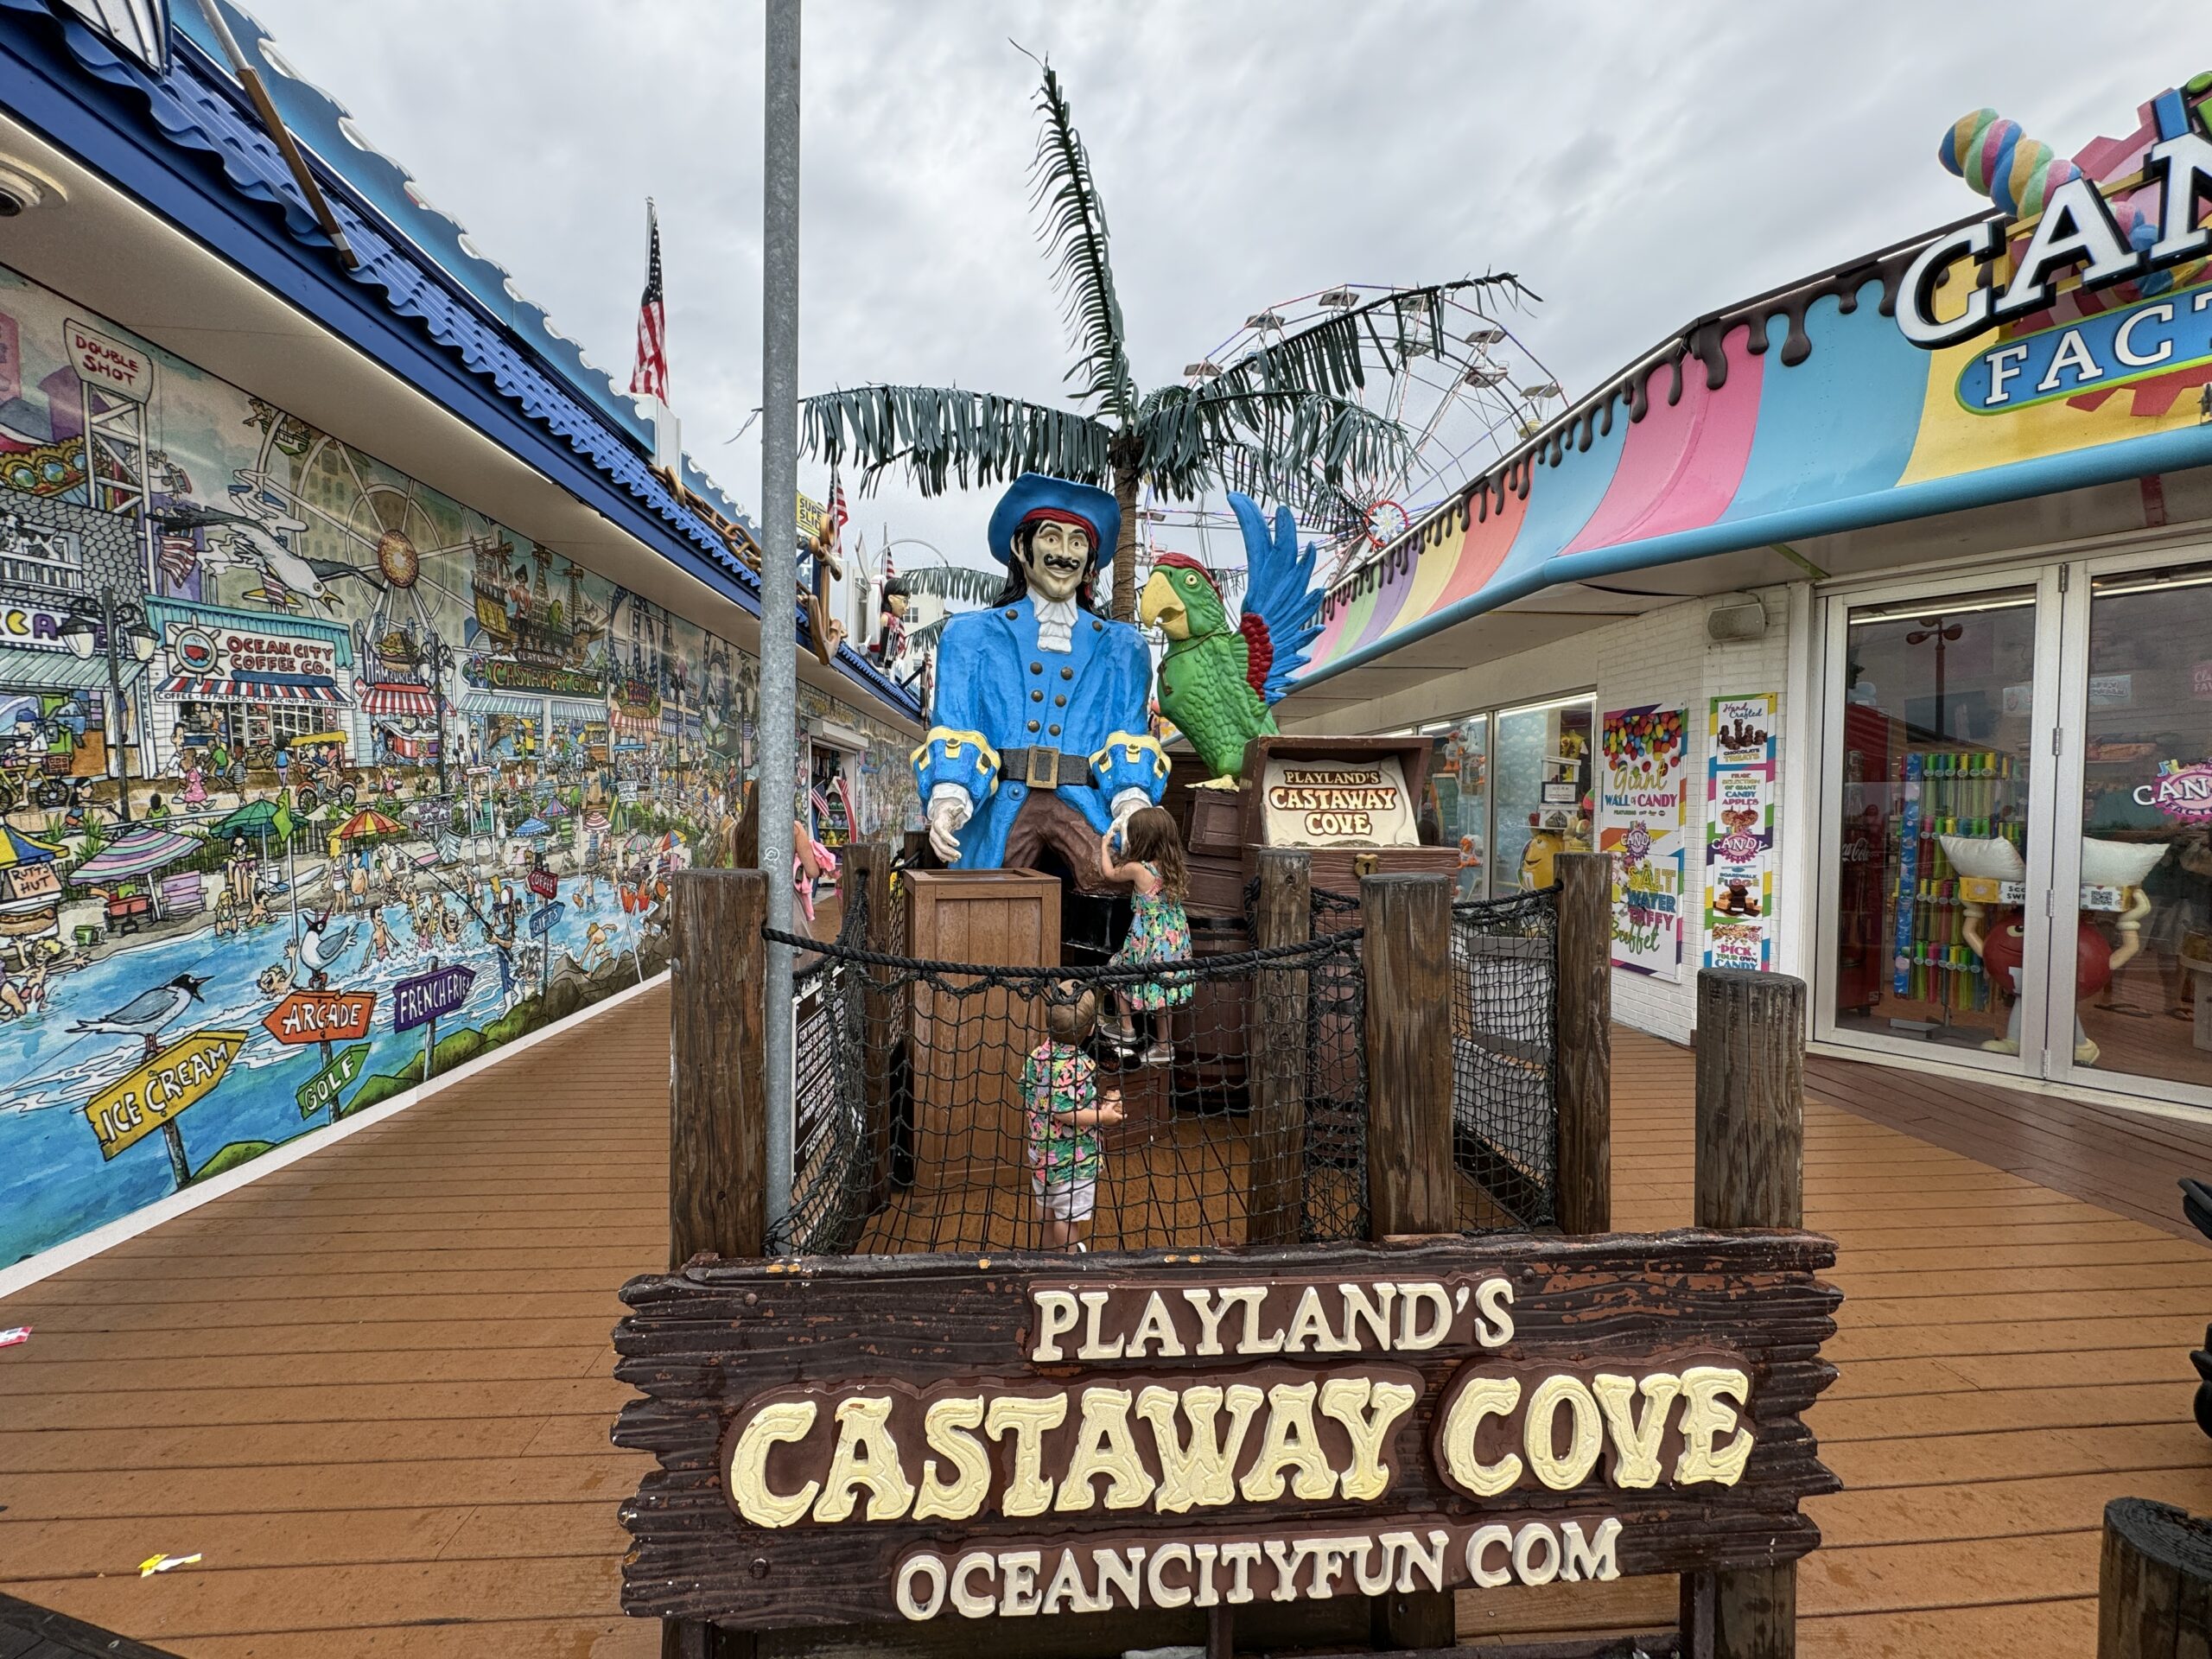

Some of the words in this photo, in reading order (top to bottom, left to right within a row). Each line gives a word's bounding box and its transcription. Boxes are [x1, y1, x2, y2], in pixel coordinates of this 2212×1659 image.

[75, 334, 139, 373] DOUBLE
[83, 353, 137, 386] SHOT
[800, 498, 822, 520] SUPE
[226, 635, 292, 656] OCEAN
[294, 647, 334, 664] CITY
[230, 655, 296, 673] COFFEE
[303, 658, 332, 676] CO.
[493, 662, 569, 691] CASTAWAY
[200, 694, 248, 702] ESPRESSO
[1723, 702, 1747, 714] Hand
[1730, 709, 1763, 719] Crafted
[1286, 770, 1380, 785] PLAYLAND'S
[1270, 787, 1395, 810] CASTAWAY
[1605, 794, 1630, 806] WALL
[1637, 793, 1677, 807] CANDY
[2133, 778, 2212, 805] CAN
[1306, 813, 1371, 835] COVE
[1712, 836, 1769, 853] CANDY
[21, 879, 50, 893] HUT
[531, 873, 556, 893] COFFEE
[1628, 866, 1676, 893] SALT
[1718, 877, 1759, 887] FUDGE
[1627, 890, 1676, 912] WATER
[532, 909, 560, 934] GIFTS
[1628, 908, 1675, 931] TAFFY
[1719, 944, 1751, 957] PICK
[1715, 959, 1758, 970] CANDY
[400, 977, 446, 1024] FRENCH
[283, 1002, 360, 1035] ARCADE
[100, 1093, 143, 1141] ICE
[144, 1042, 230, 1113] CREAM
[303, 1055, 354, 1111] GOLF
[1033, 1278, 1514, 1362] PLAYLAND'S
[730, 1377, 1416, 1528] CASTAWAY
[1441, 1366, 1754, 1497] COVE
[897, 1530, 1448, 1621] OCEANCITYFUN
[1465, 1517, 1623, 1588] COM
